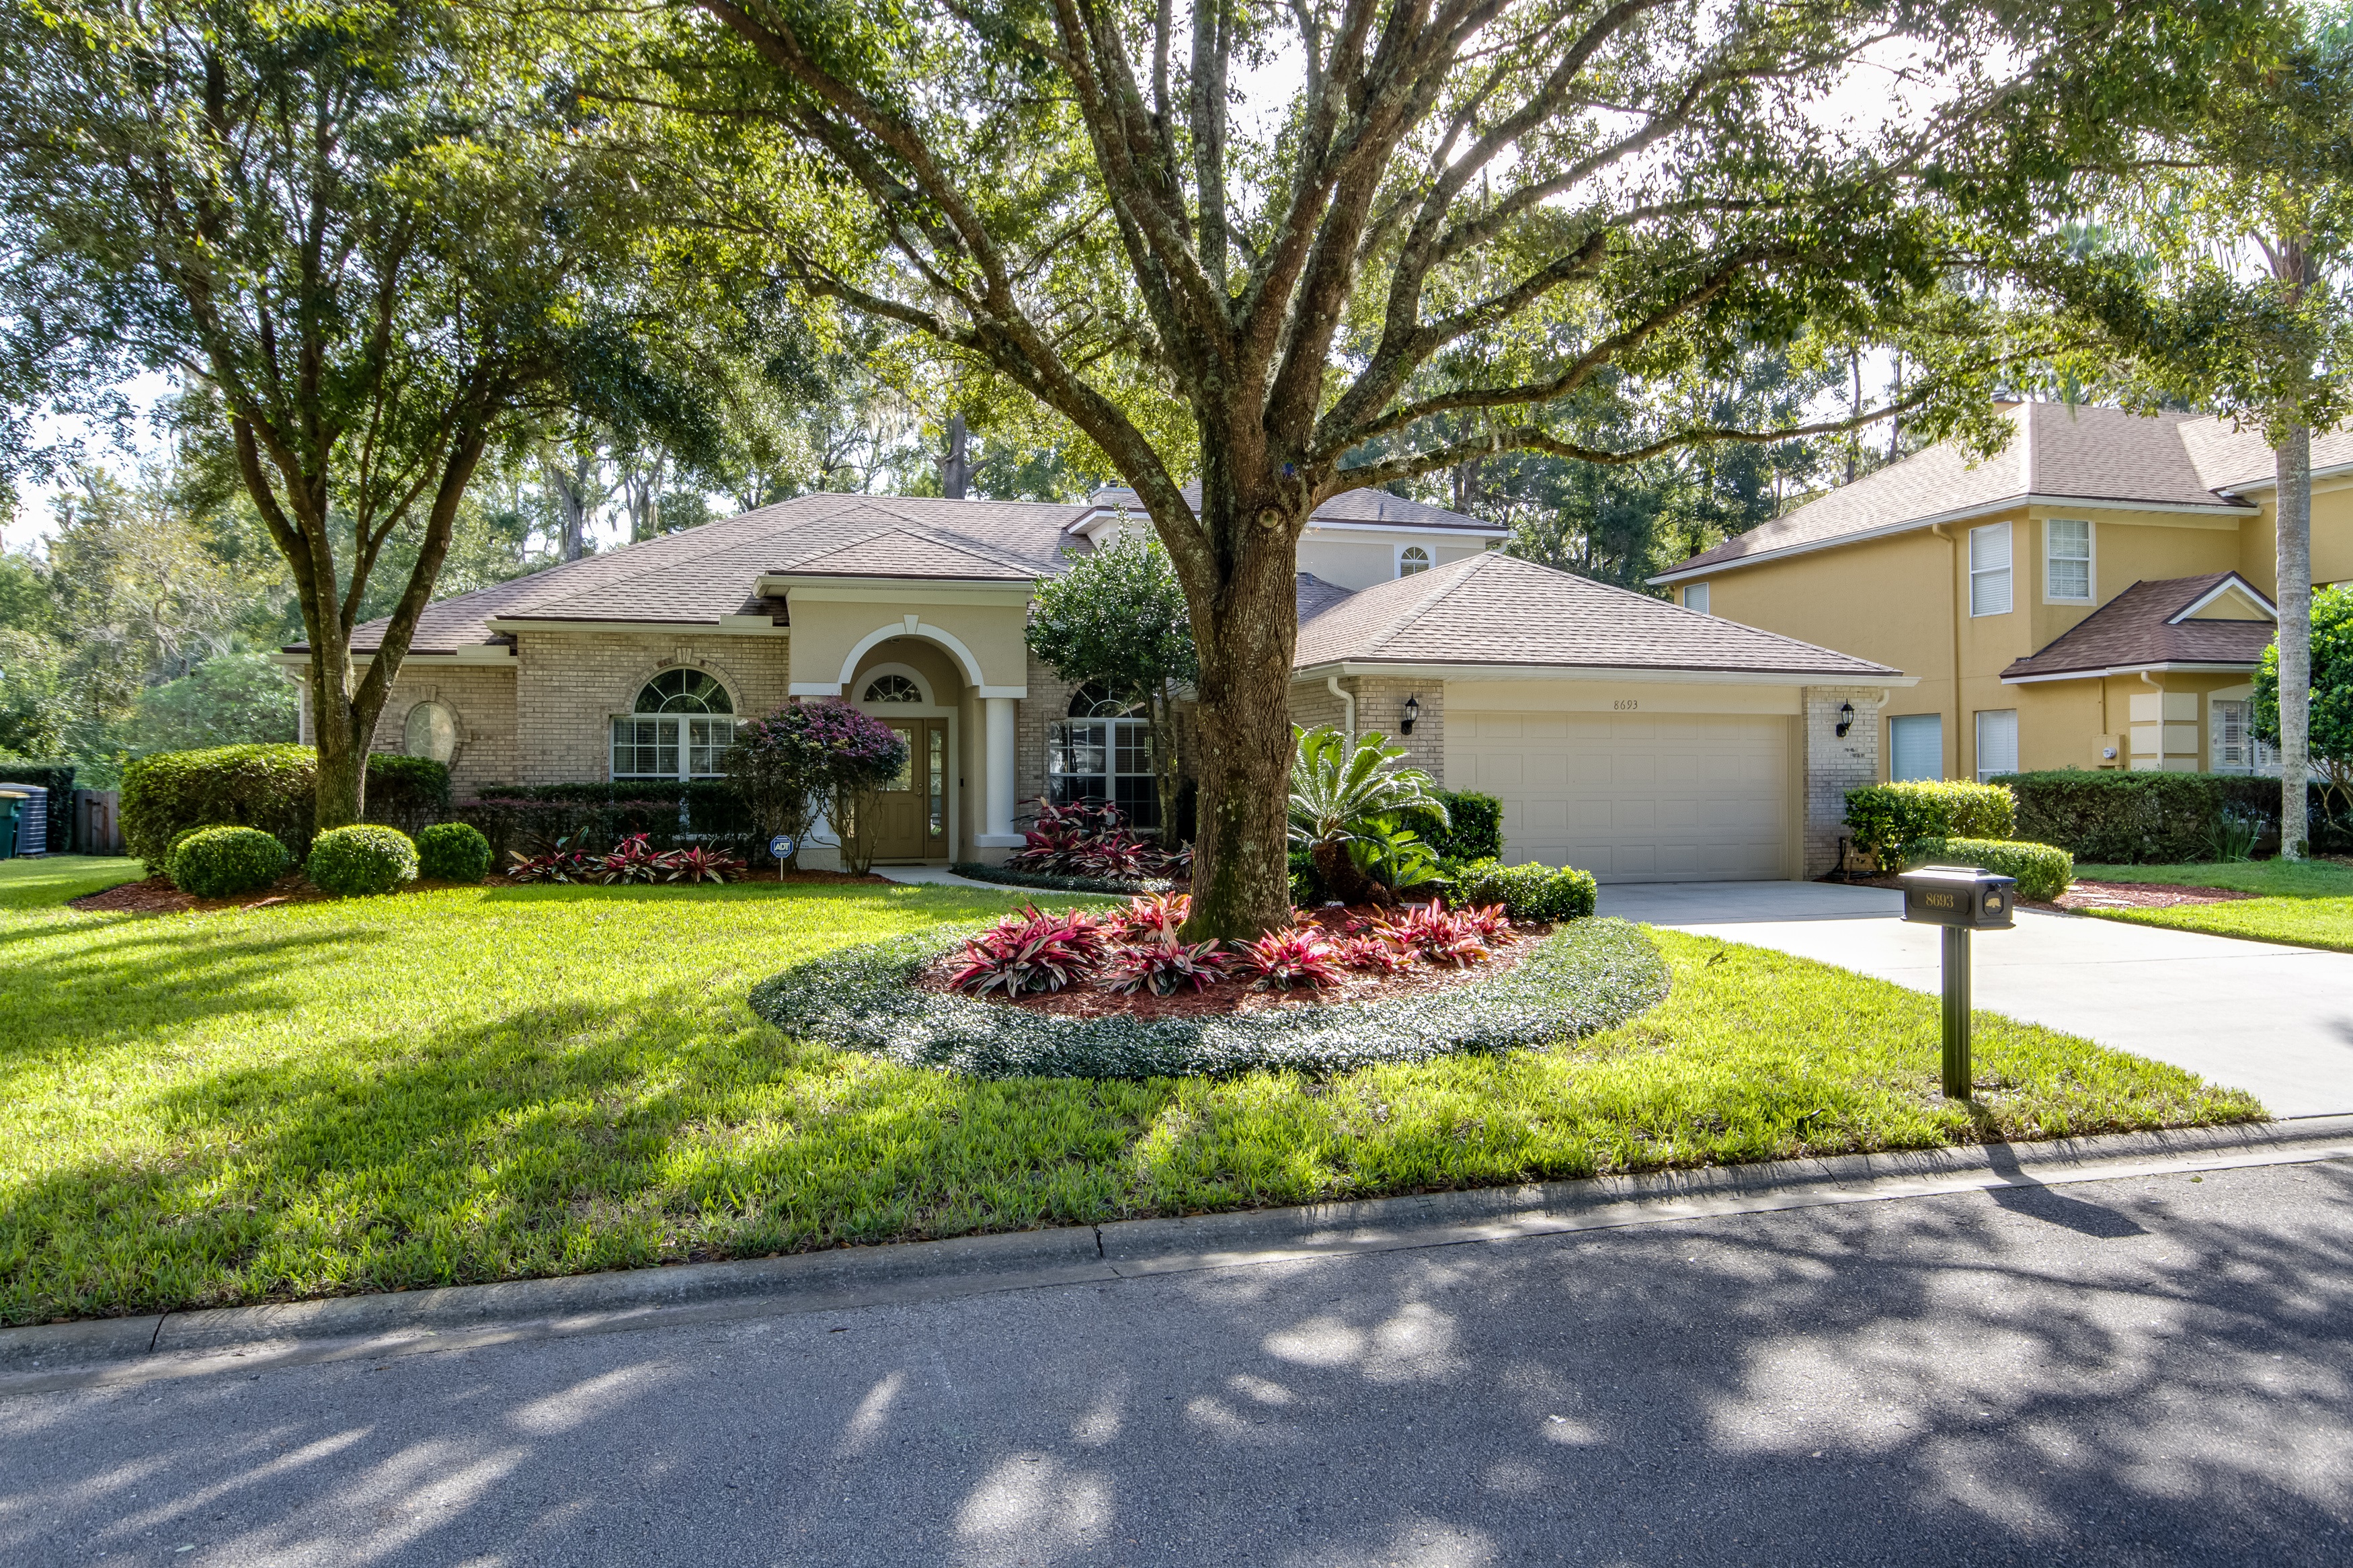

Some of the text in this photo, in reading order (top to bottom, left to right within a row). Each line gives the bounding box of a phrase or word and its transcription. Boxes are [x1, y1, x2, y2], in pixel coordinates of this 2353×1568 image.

[1614, 700, 1638, 710] 8693
[774, 843, 790, 851] ADT
[1925, 893, 1954, 908] 8693
